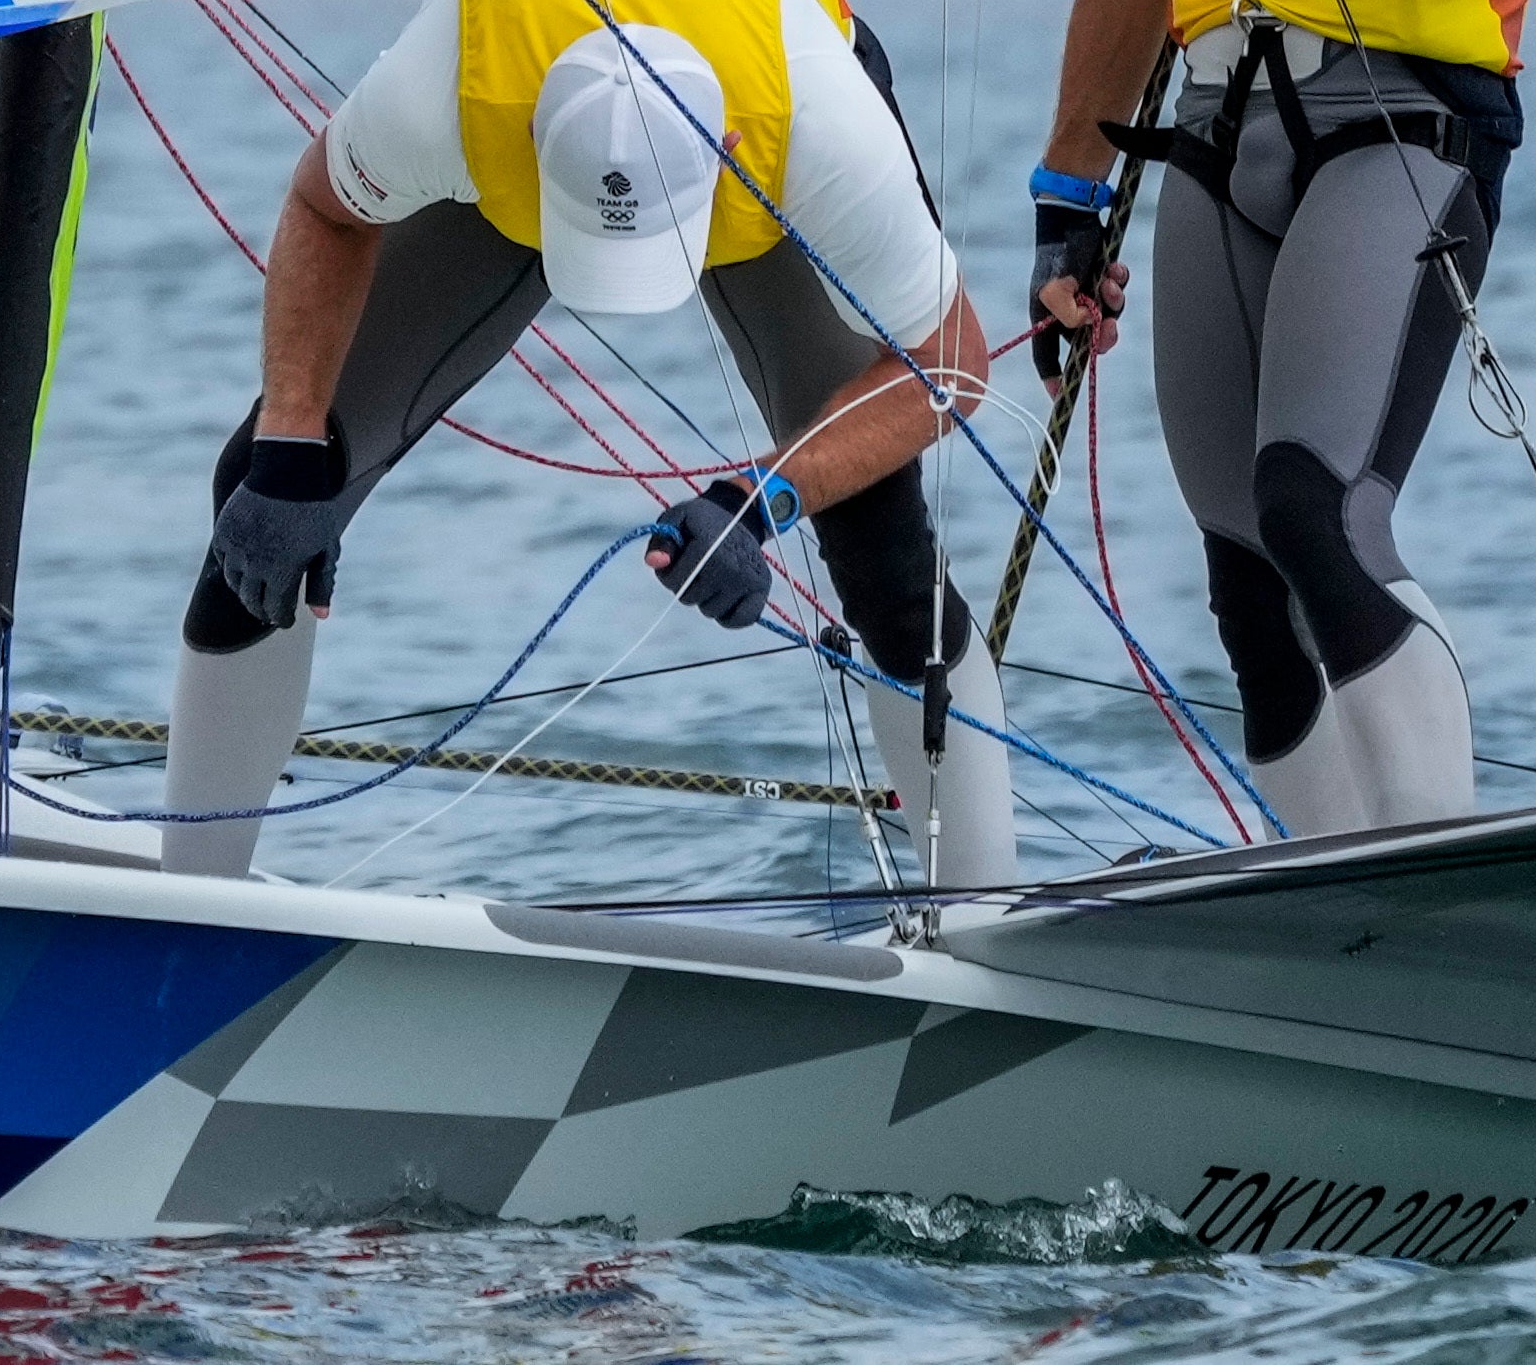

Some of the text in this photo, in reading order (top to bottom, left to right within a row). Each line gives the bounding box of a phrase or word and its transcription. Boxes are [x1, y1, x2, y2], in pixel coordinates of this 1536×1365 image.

[742, 779, 781, 800] CST
[1180, 1165, 1530, 1263] TOKYO 2020
